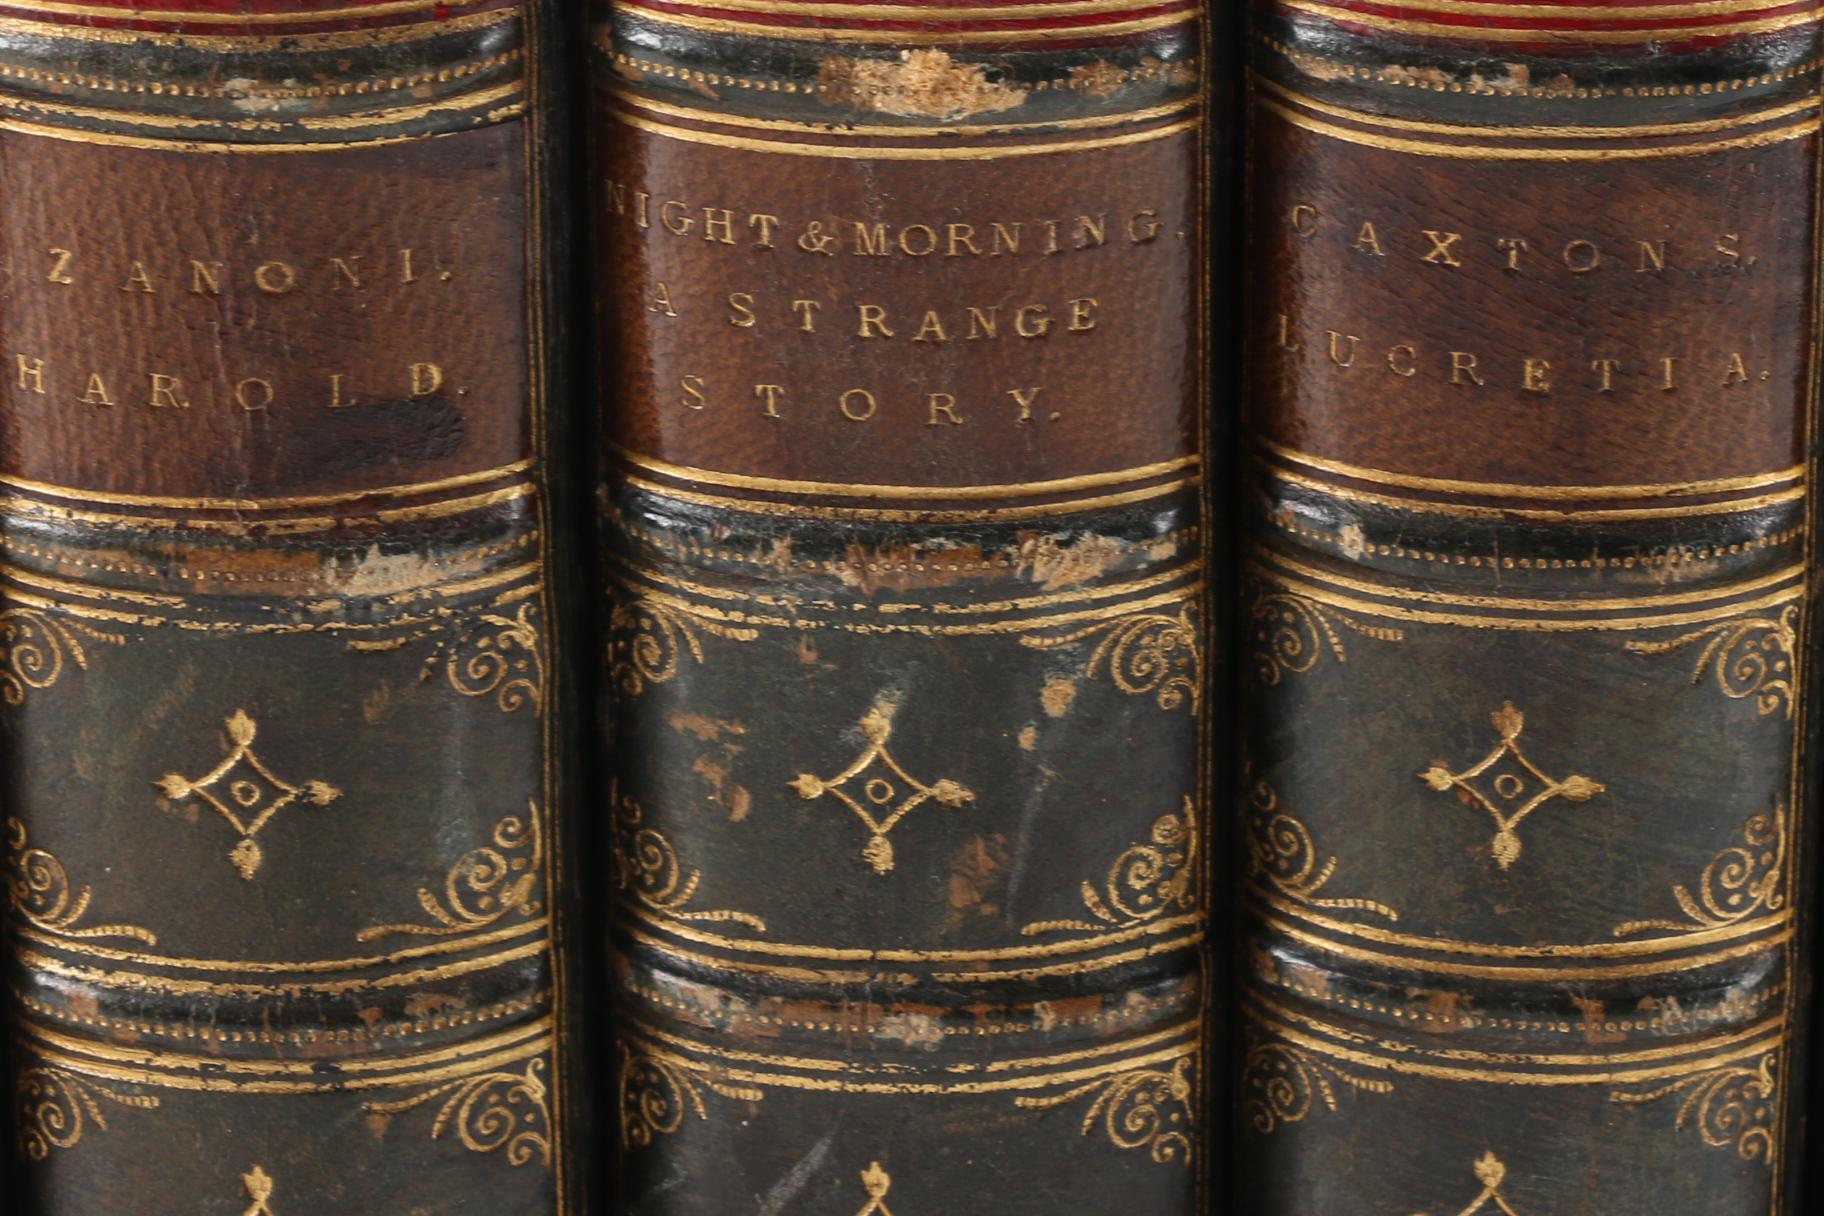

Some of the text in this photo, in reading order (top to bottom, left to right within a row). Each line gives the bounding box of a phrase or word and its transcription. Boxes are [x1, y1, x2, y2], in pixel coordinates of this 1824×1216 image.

[604, 179, 779, 249] NIGHT
[47, 248, 453, 294] ZANONI.
[648, 282, 1100, 342] A STRANGE
[1276, 314, 1772, 392] LUCRETIA.
[680, 375, 1062, 425] STORY.
